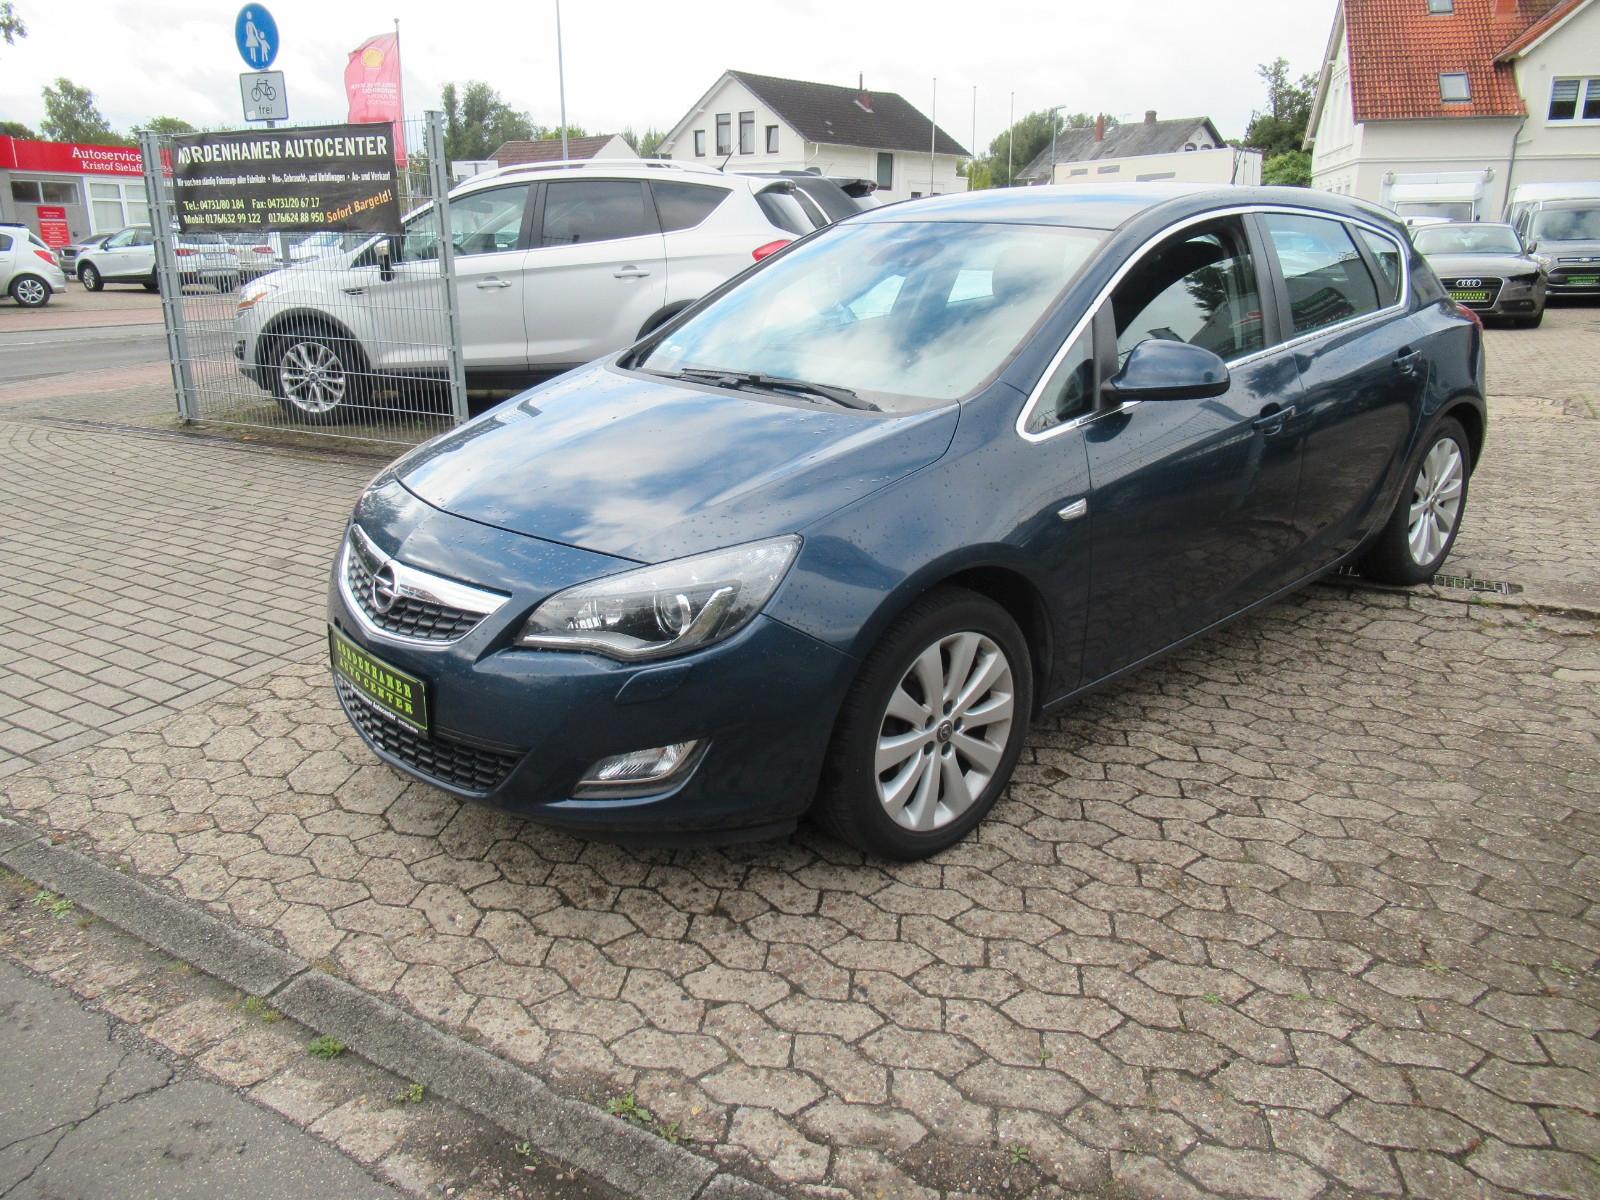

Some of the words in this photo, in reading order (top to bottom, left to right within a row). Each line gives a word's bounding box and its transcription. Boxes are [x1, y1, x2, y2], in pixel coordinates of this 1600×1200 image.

[258, 104, 273, 115] frei
[285, 136, 387, 158] AUTOCENTER
[72, 147, 142, 162] Autoservice
[82, 161, 113, 171] Kristof
[114, 163, 143, 172] Sielaff
[200, 199, 230, 210] 04731/80
[232, 199, 244, 209] 184
[251, 198, 267, 209] Fax:
[267, 197, 299, 208] 04731/20
[301, 196, 309, 208] 67
[311, 196, 320, 208] 17
[326, 204, 352, 223] Sofort
[354, 189, 393, 213] Bargeld!
[184, 214, 205, 224] Mobil:
[205, 213, 236, 224] 0176/632
[237, 213, 246, 223] 99
[248, 213, 261, 223] 122
[268, 212, 299, 223] 0176/624
[300, 212, 309, 223] 88
[311, 211, 324, 223] 950
[364, 678, 413, 715] CENTER
